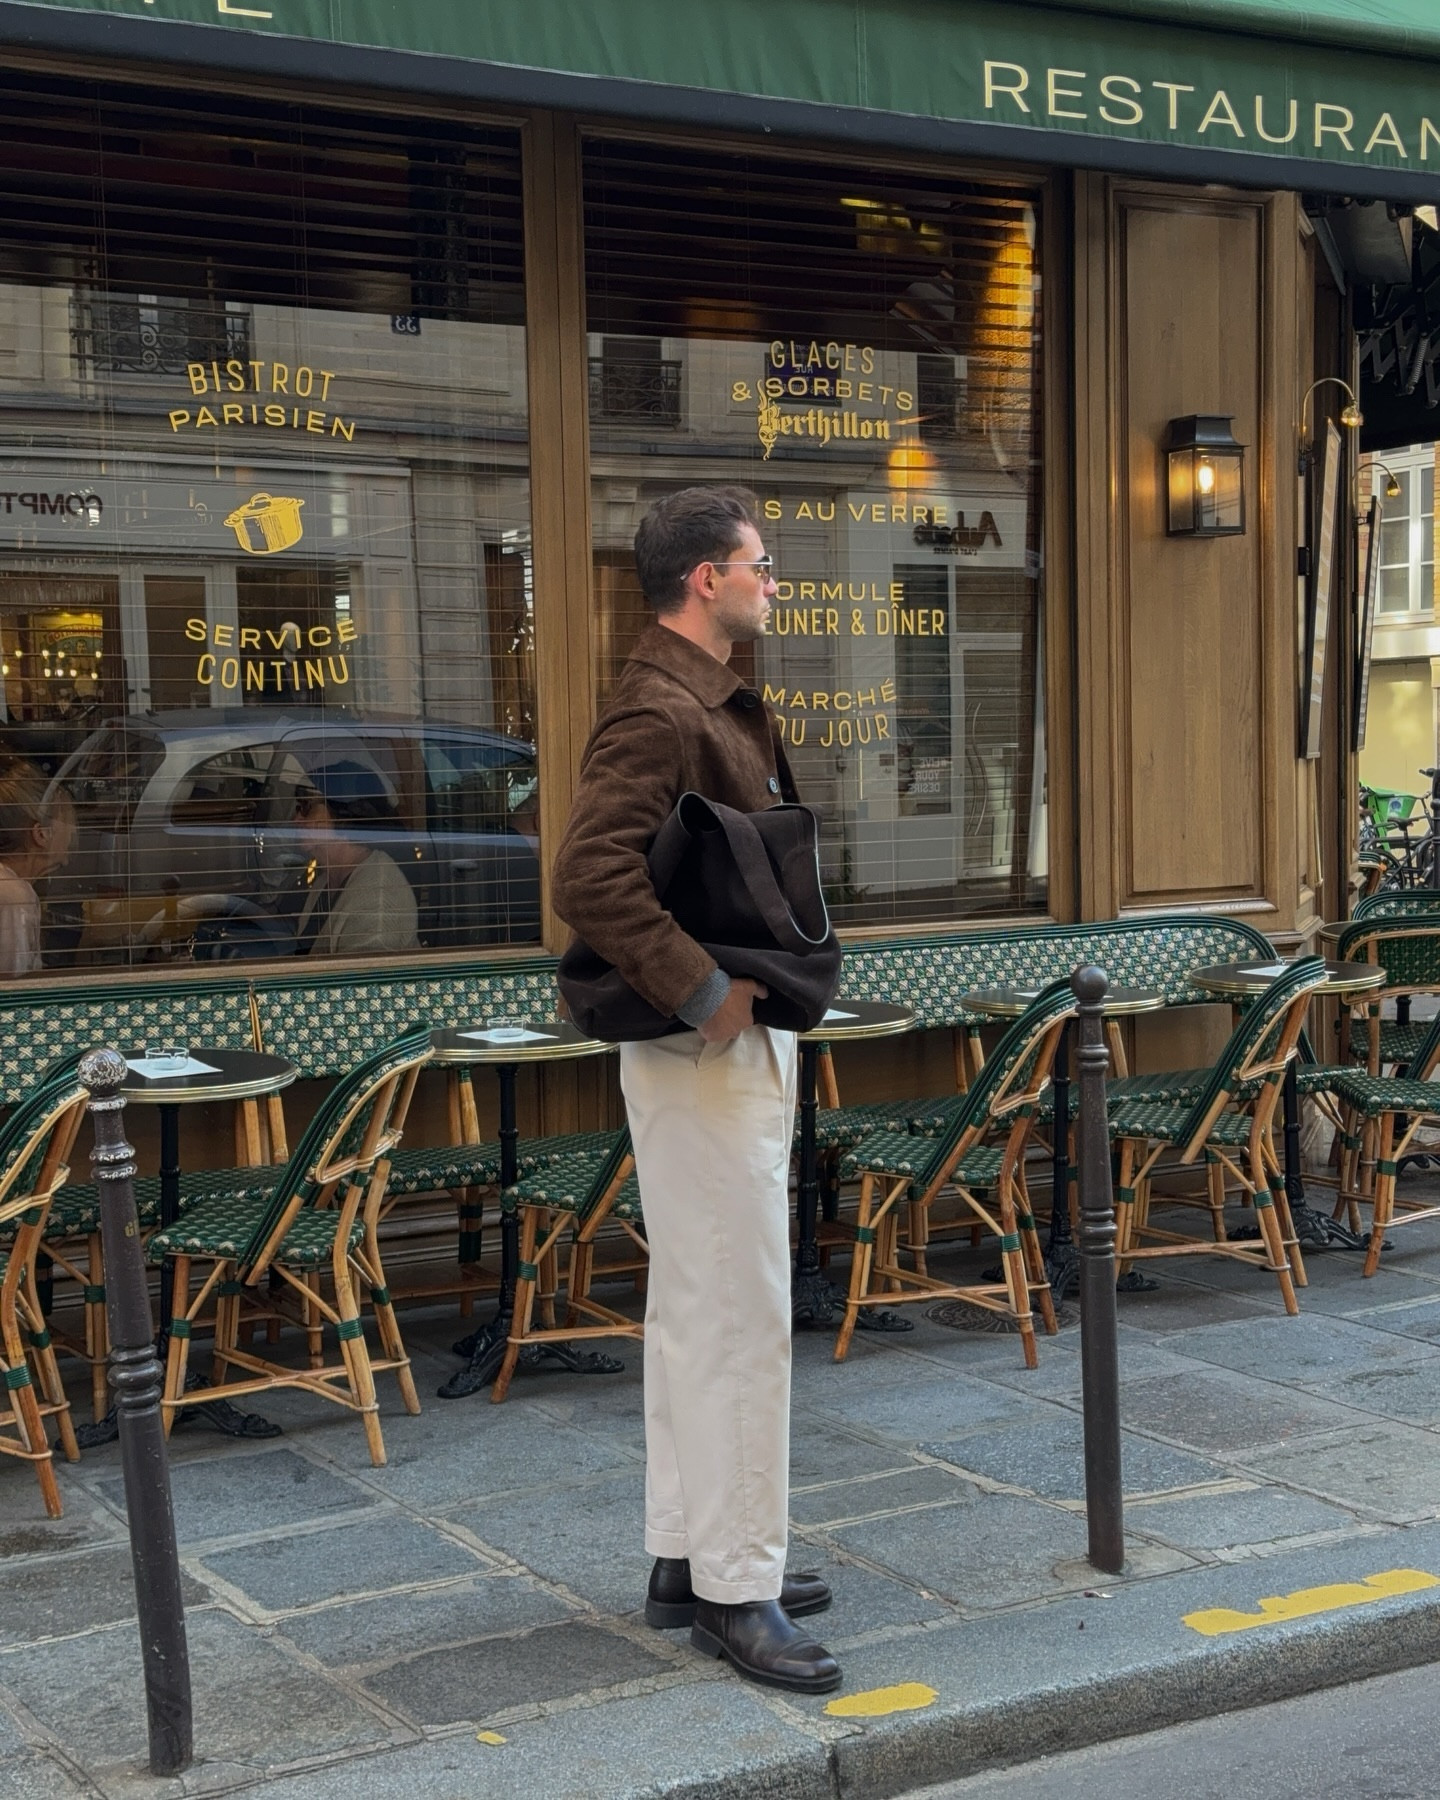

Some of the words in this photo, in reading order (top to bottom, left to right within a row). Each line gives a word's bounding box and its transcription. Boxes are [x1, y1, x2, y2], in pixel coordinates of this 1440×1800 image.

[770, 340, 875, 374] GLACES
[187, 359, 336, 401] BISTROT
[732, 381, 752, 401] &
[765, 376, 913, 412] SORBETS
[168, 403, 356, 441] PARISIEN
[757, 379, 891, 461] Berthillon
[796, 502, 835, 521] AU
[848, 503, 948, 524] VERRE
[775, 582, 904, 601] ORMULE
[184, 618, 358, 649] SERVICE
[764, 608, 840, 635] EUNER
[851, 608, 867, 636] &
[876, 602, 945, 635] DÎNER
[197, 654, 349, 692] CONTINU
[762, 678, 897, 711] MARCHÉ
[820, 713, 891, 747] JOUR
